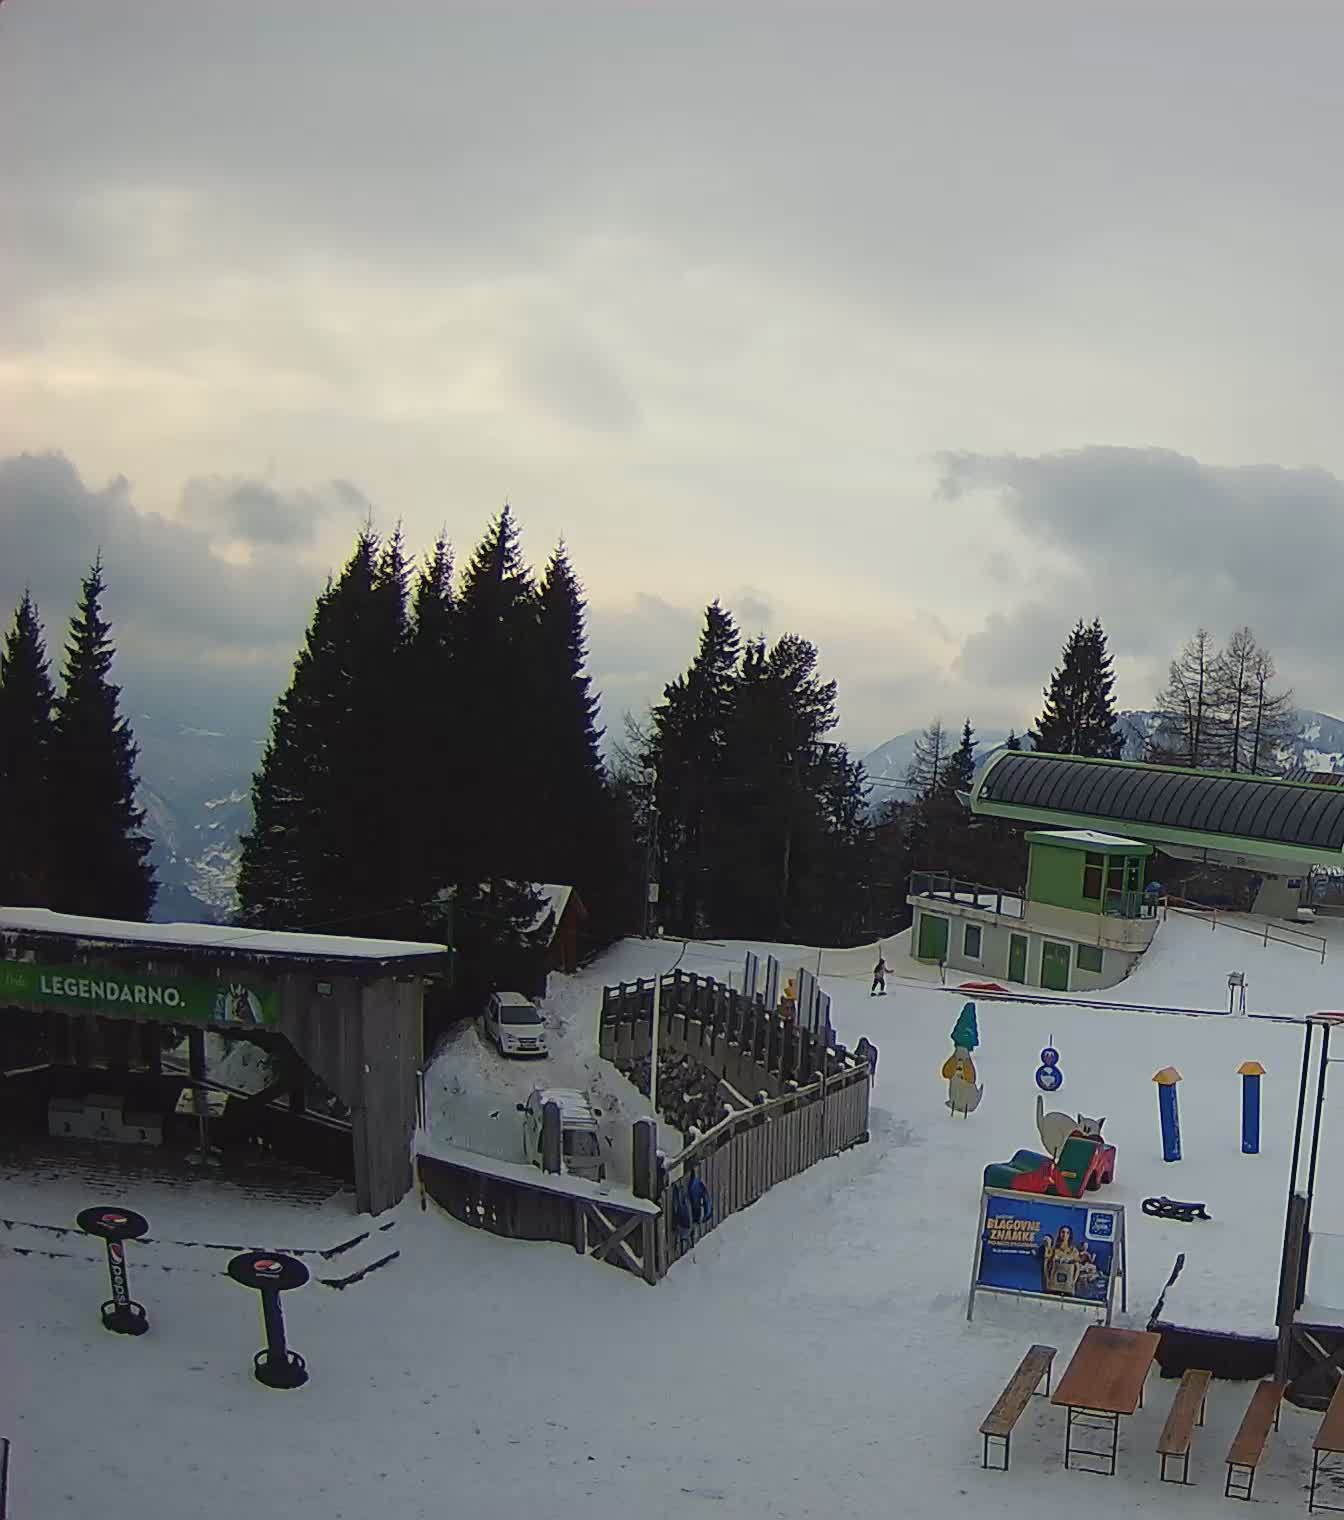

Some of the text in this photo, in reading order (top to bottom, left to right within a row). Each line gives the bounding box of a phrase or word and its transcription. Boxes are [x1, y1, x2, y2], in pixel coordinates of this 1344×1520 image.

[40, 974, 187, 1008] LEGENDARNO.
[990, 1229, 1036, 1242] ZNAMKE
[111, 1263, 129, 1307] pepsi
